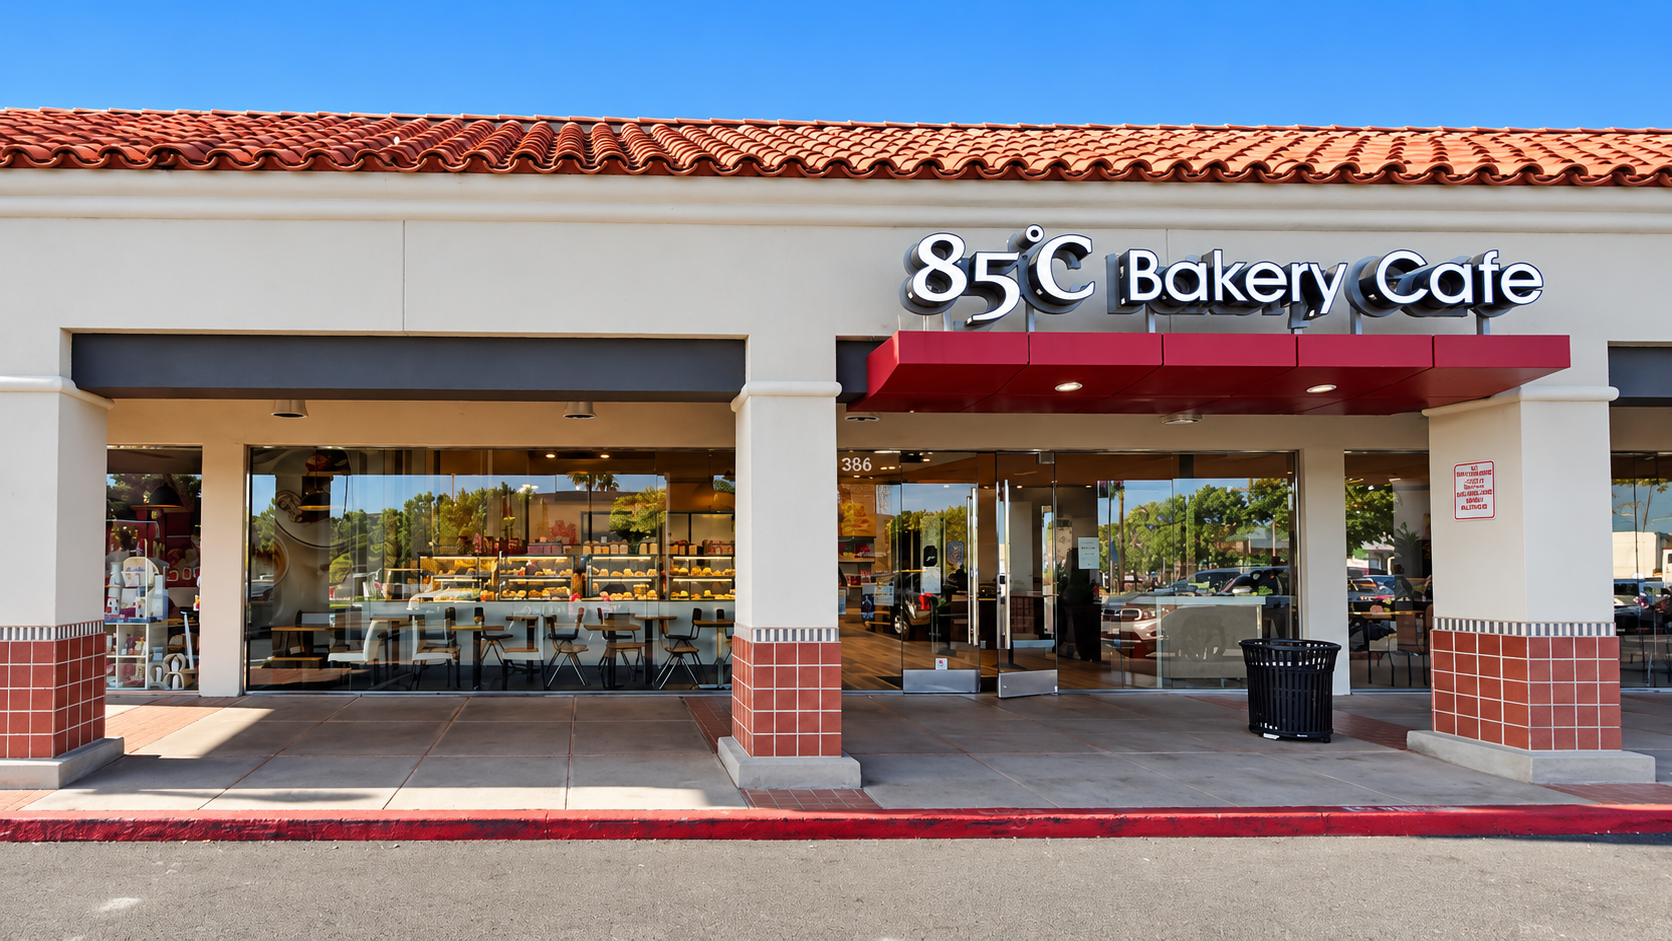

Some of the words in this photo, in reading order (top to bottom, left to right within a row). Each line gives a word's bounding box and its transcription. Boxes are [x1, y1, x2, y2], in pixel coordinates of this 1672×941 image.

[1128, 248, 1349, 315] Bakery
[1375, 248, 1544, 306] Cafe
[841, 456, 872, 472] 386
